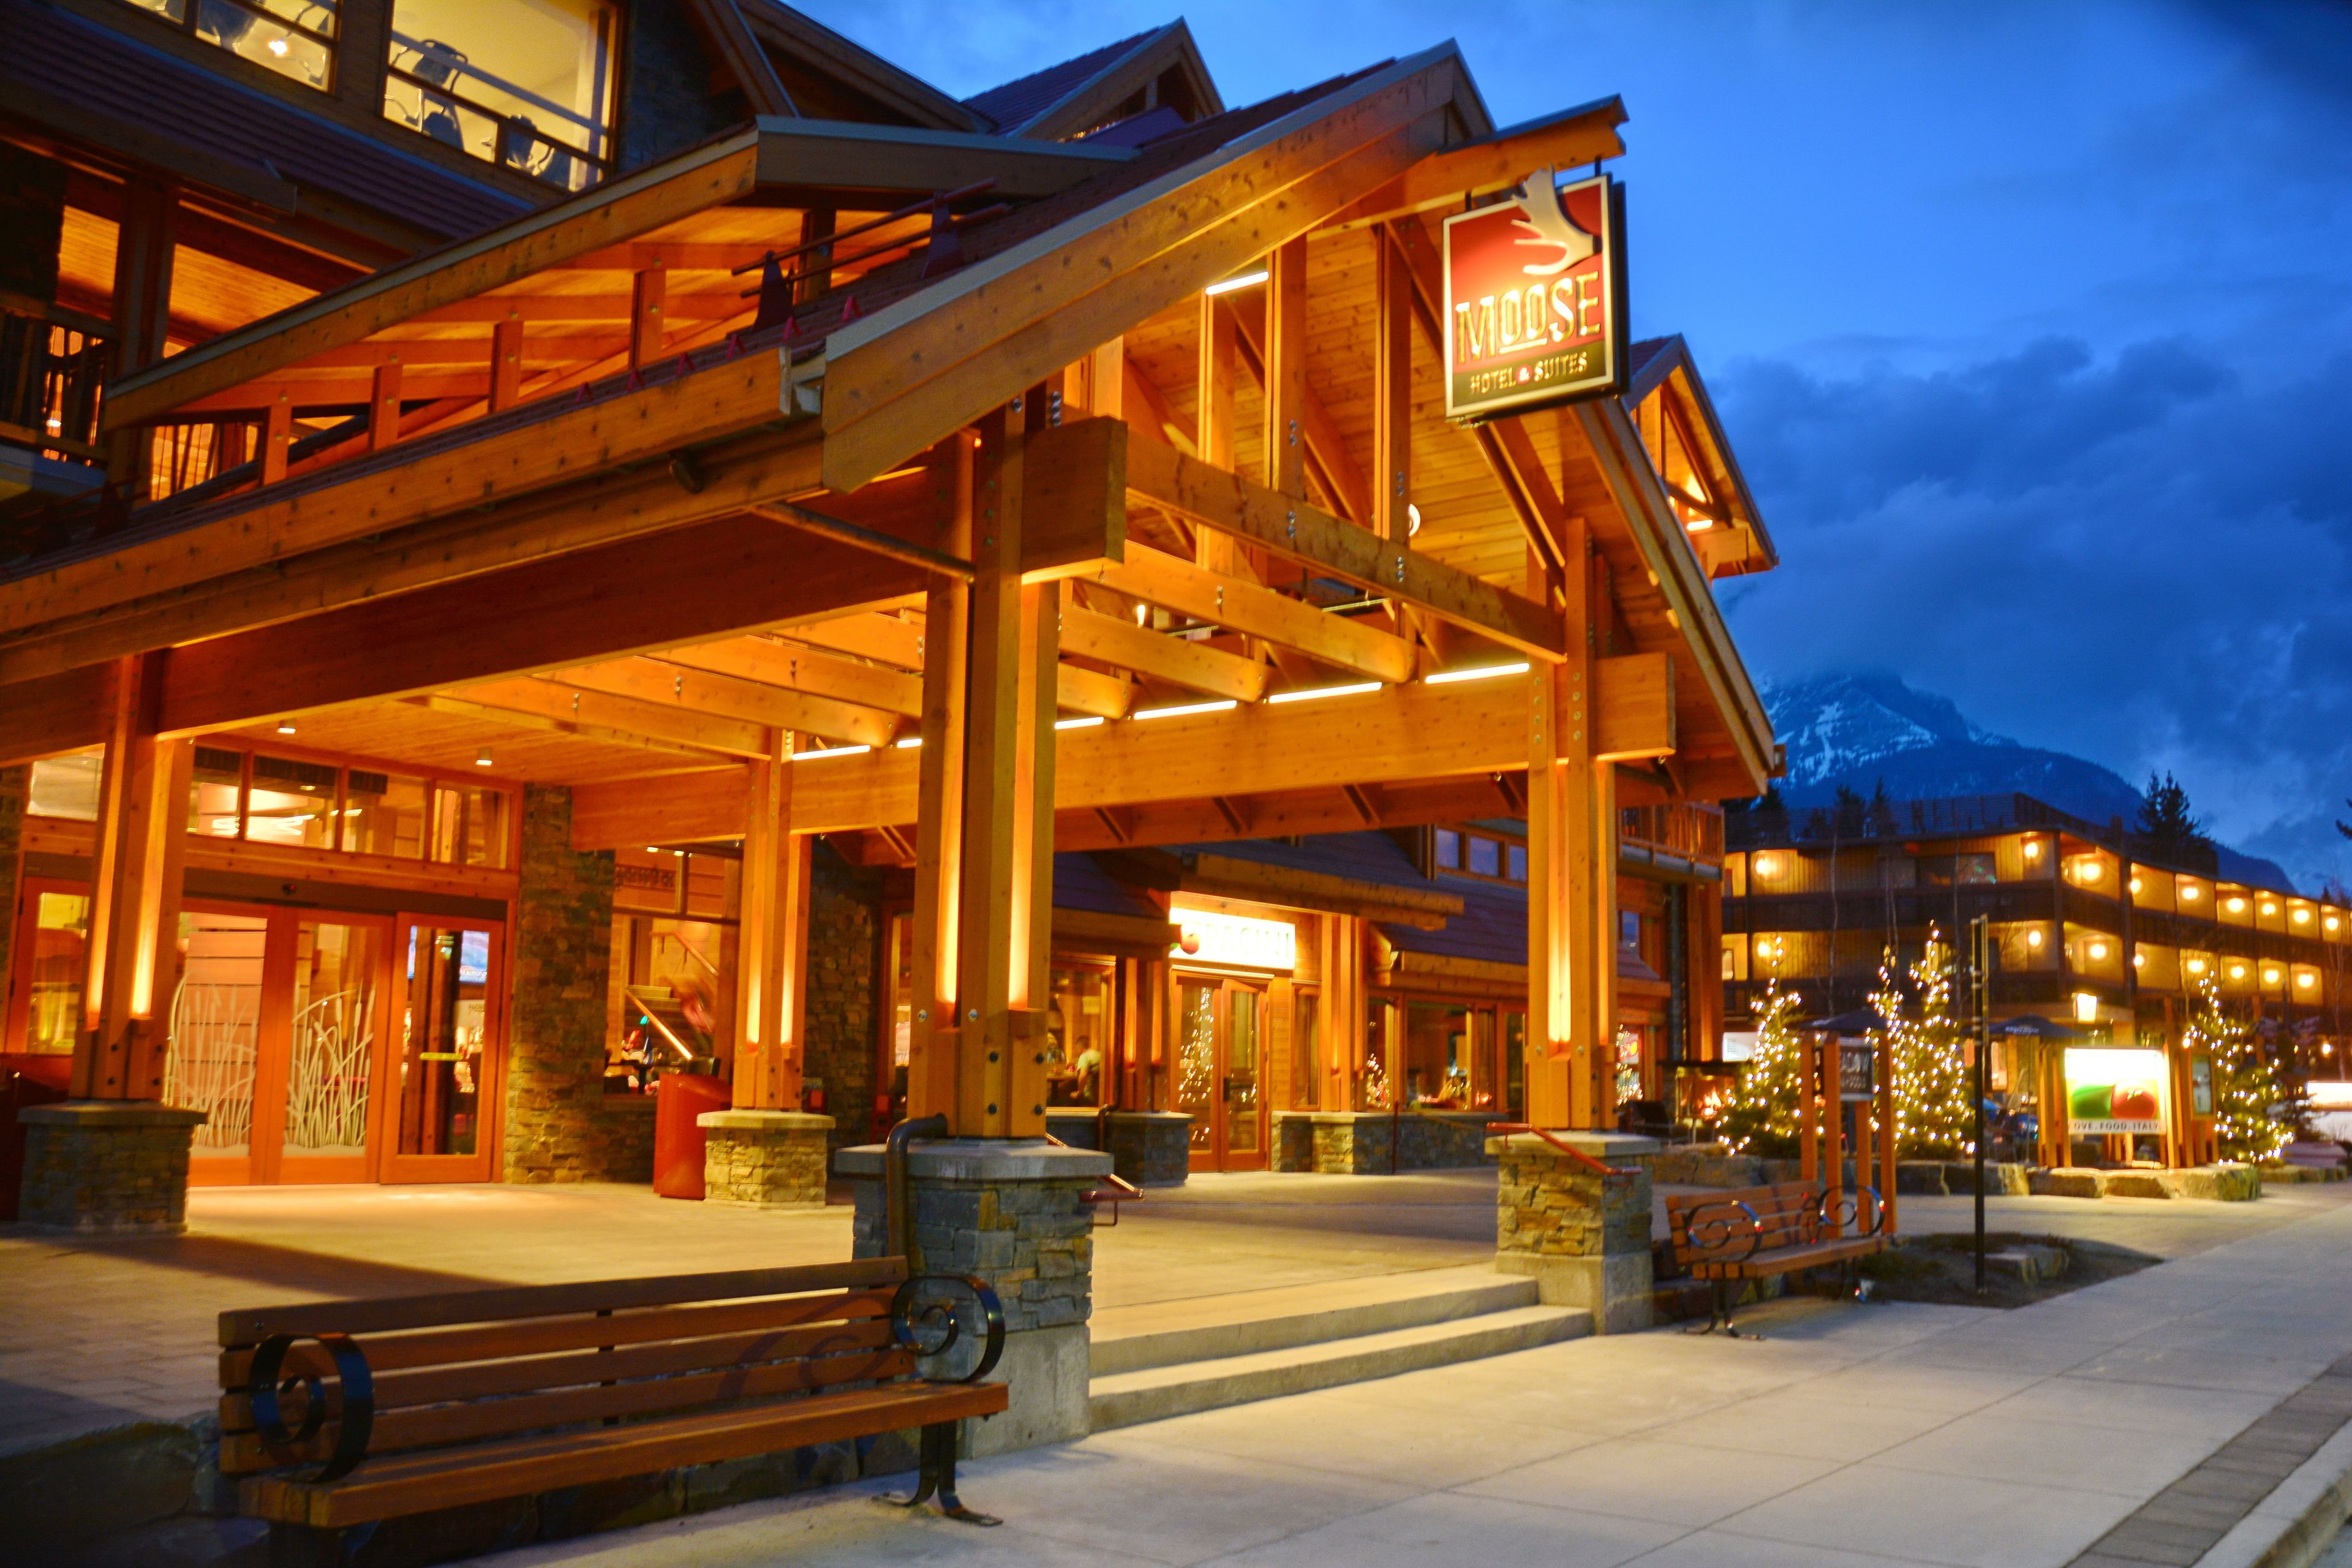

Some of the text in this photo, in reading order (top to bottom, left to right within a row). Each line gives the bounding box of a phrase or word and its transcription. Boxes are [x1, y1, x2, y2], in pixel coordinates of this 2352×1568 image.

[1455, 271, 1600, 363] MOOSE
[1471, 351, 1588, 394] HOTEL & SUITES
[1205, 922, 1289, 959] PACINI
